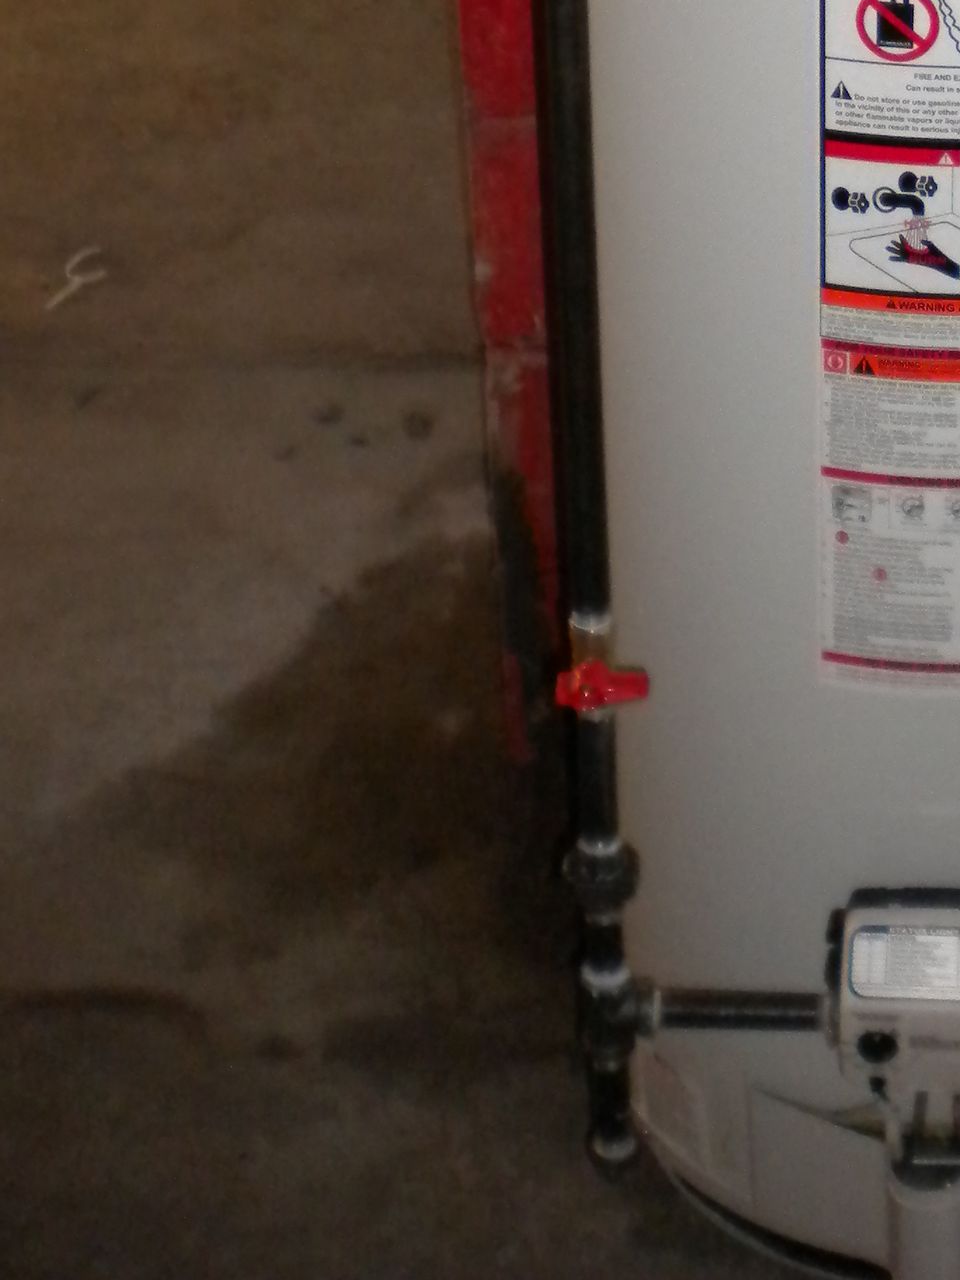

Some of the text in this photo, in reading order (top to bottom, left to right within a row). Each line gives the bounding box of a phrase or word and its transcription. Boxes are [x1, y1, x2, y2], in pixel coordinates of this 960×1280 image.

[934, 73, 952, 81] AND
[905, 84, 921, 92] Can
[897, 299, 953, 312] WARNING
